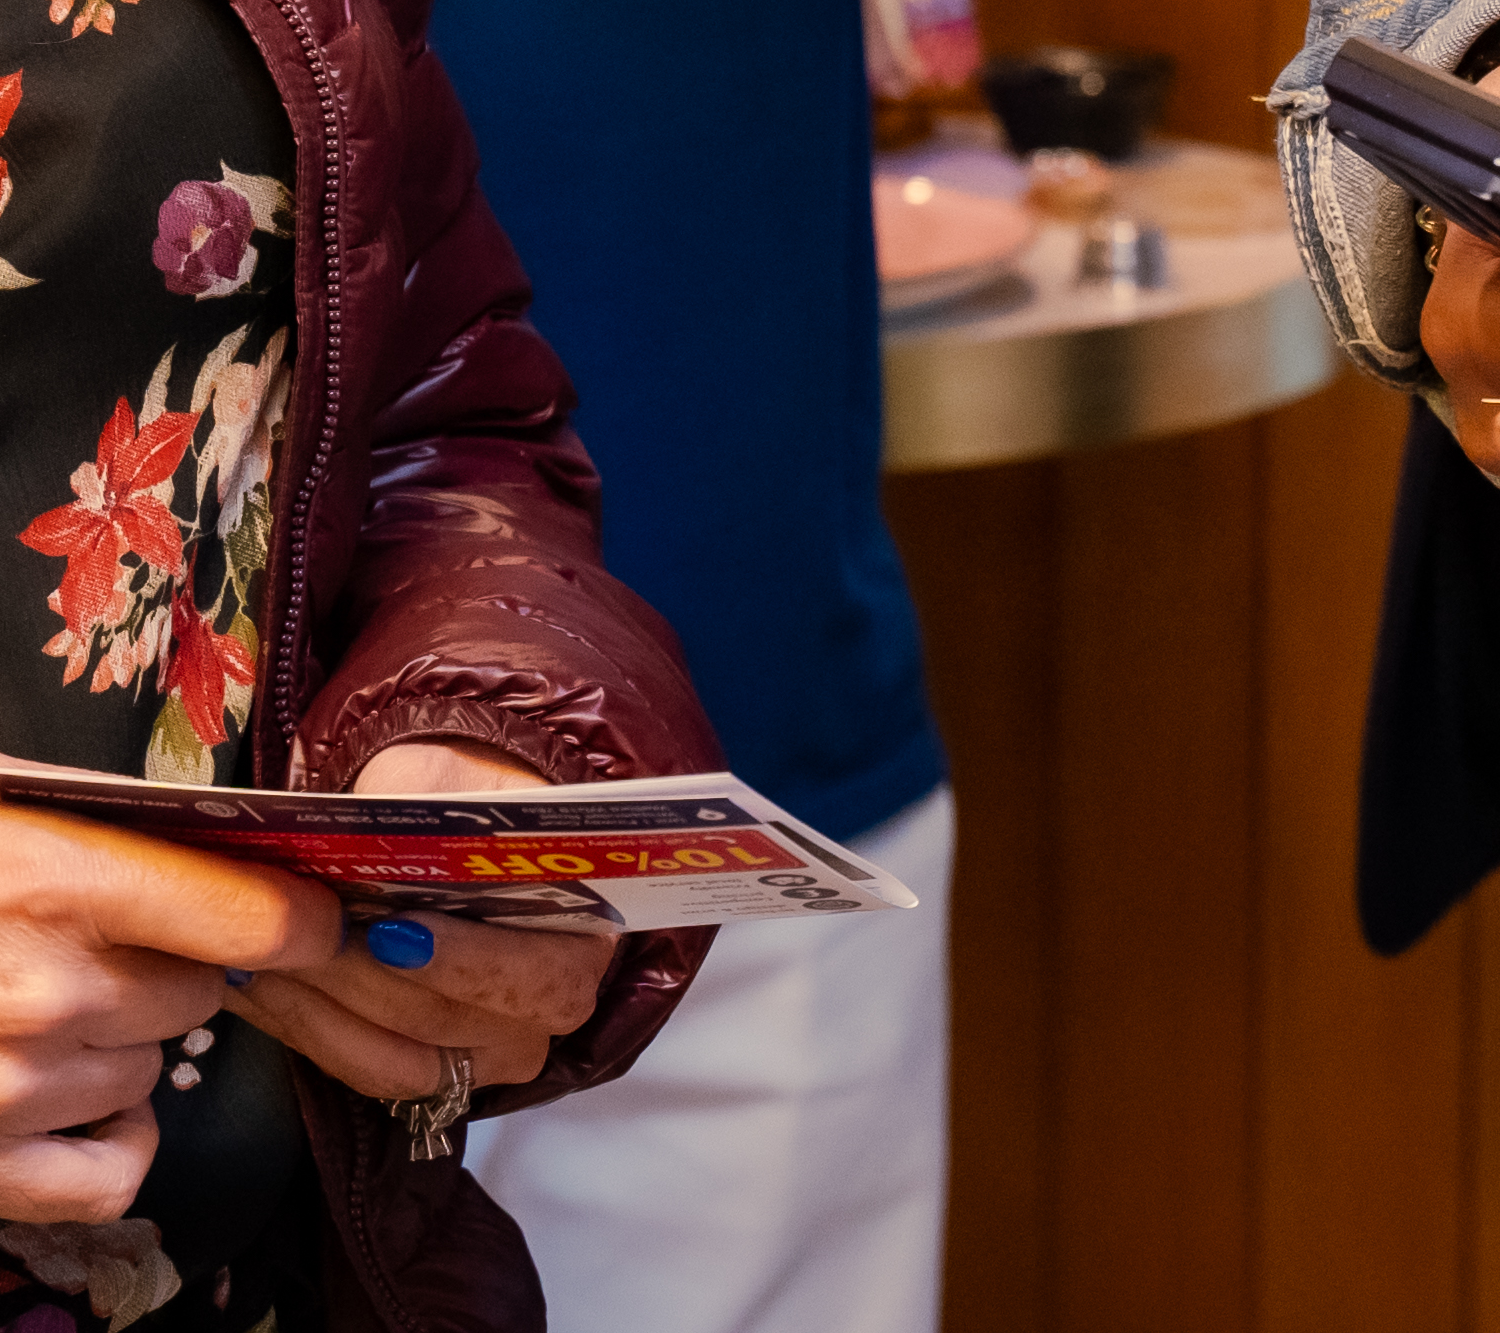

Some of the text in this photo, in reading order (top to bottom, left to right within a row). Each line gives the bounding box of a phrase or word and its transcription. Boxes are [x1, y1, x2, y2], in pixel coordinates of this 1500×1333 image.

[351, 865, 451, 876] YOUR
[463, 853, 595, 875] OFF
[606, 847, 772, 872] 10%
